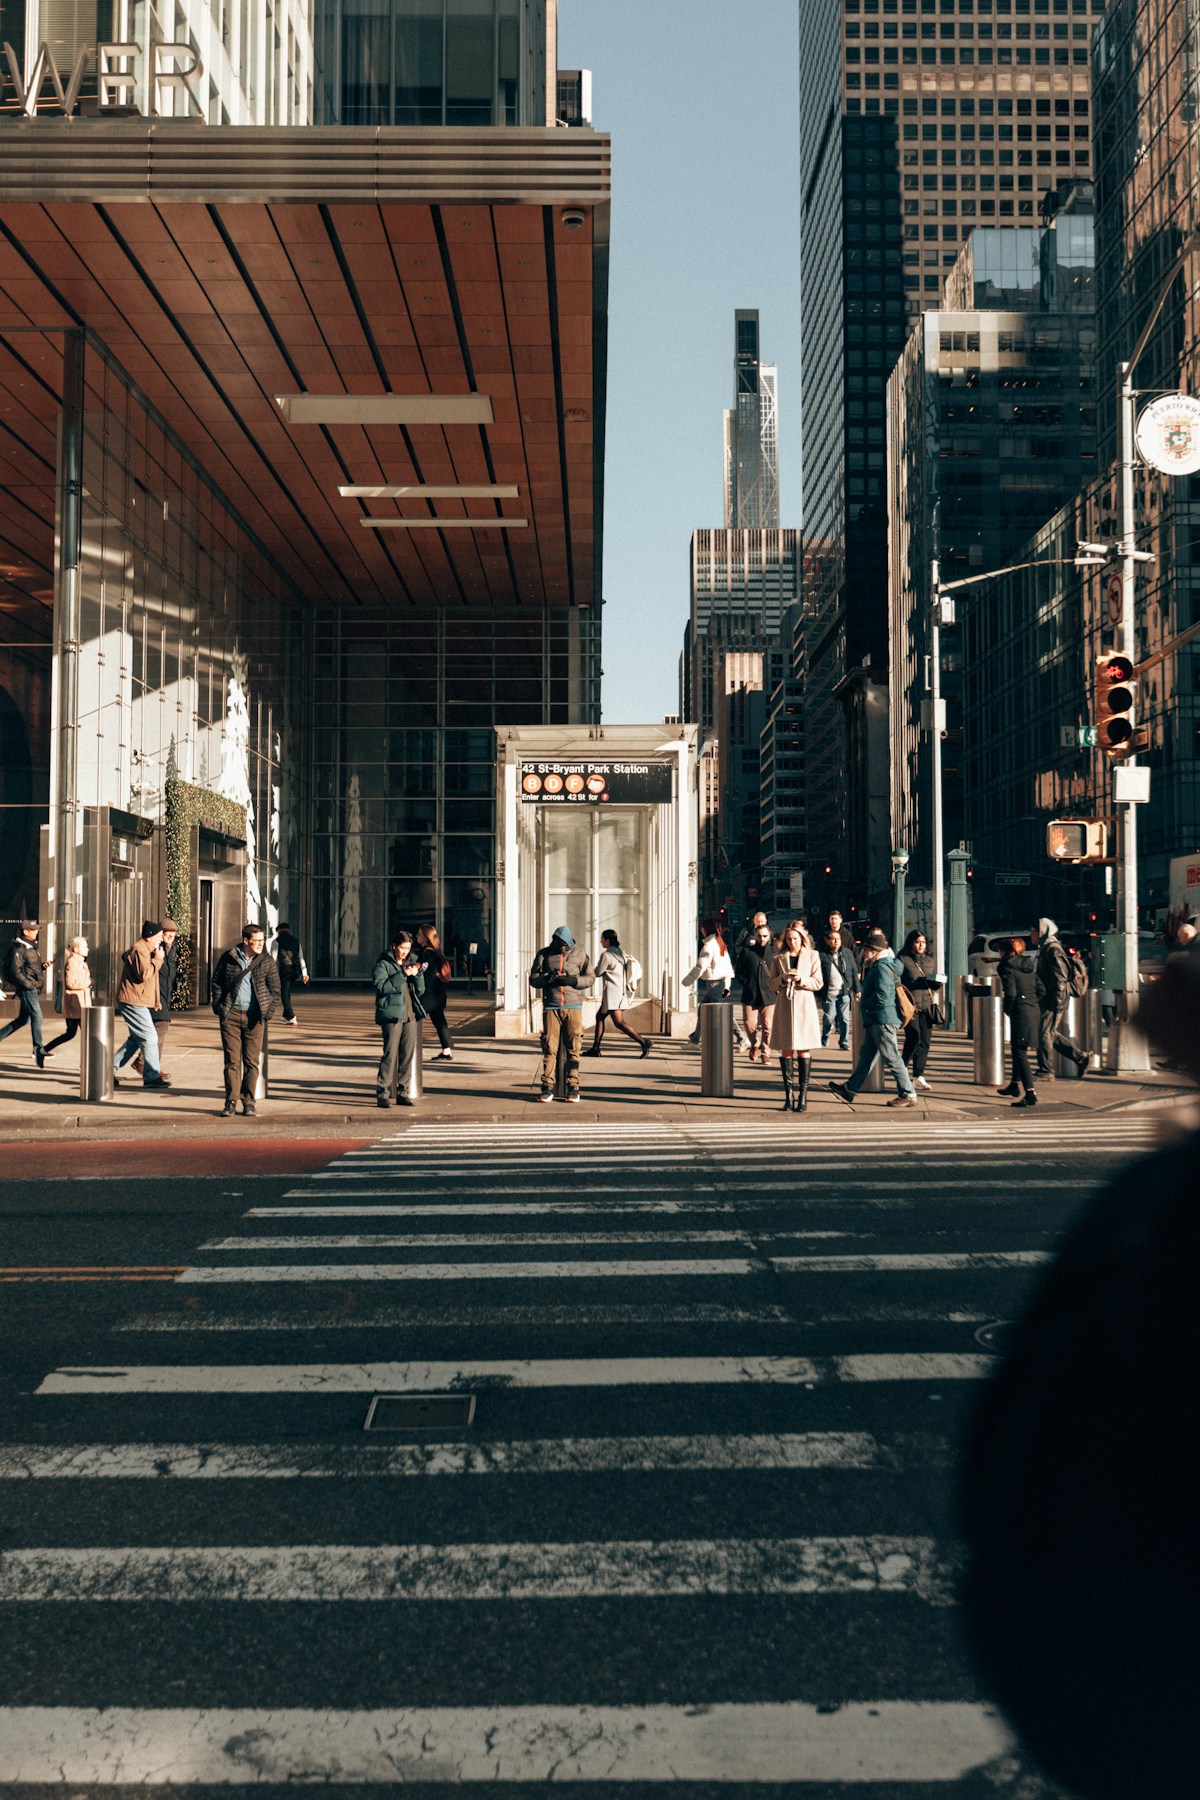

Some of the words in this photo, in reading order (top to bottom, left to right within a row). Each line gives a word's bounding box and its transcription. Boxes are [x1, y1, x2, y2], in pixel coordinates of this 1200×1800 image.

[0, 41, 205, 118] WER
[1151, 403, 1183, 419] PUERTO
[1185, 404, 1200, 417] RIC
[522, 764, 535, 774] 42
[538, 764, 585, 775] St-Bryant
[587, 764, 610, 774] Park
[613, 764, 649, 774] Station
[528, 778, 538, 789] B
[549, 778, 559, 789] D
[570, 778, 579, 789] F
